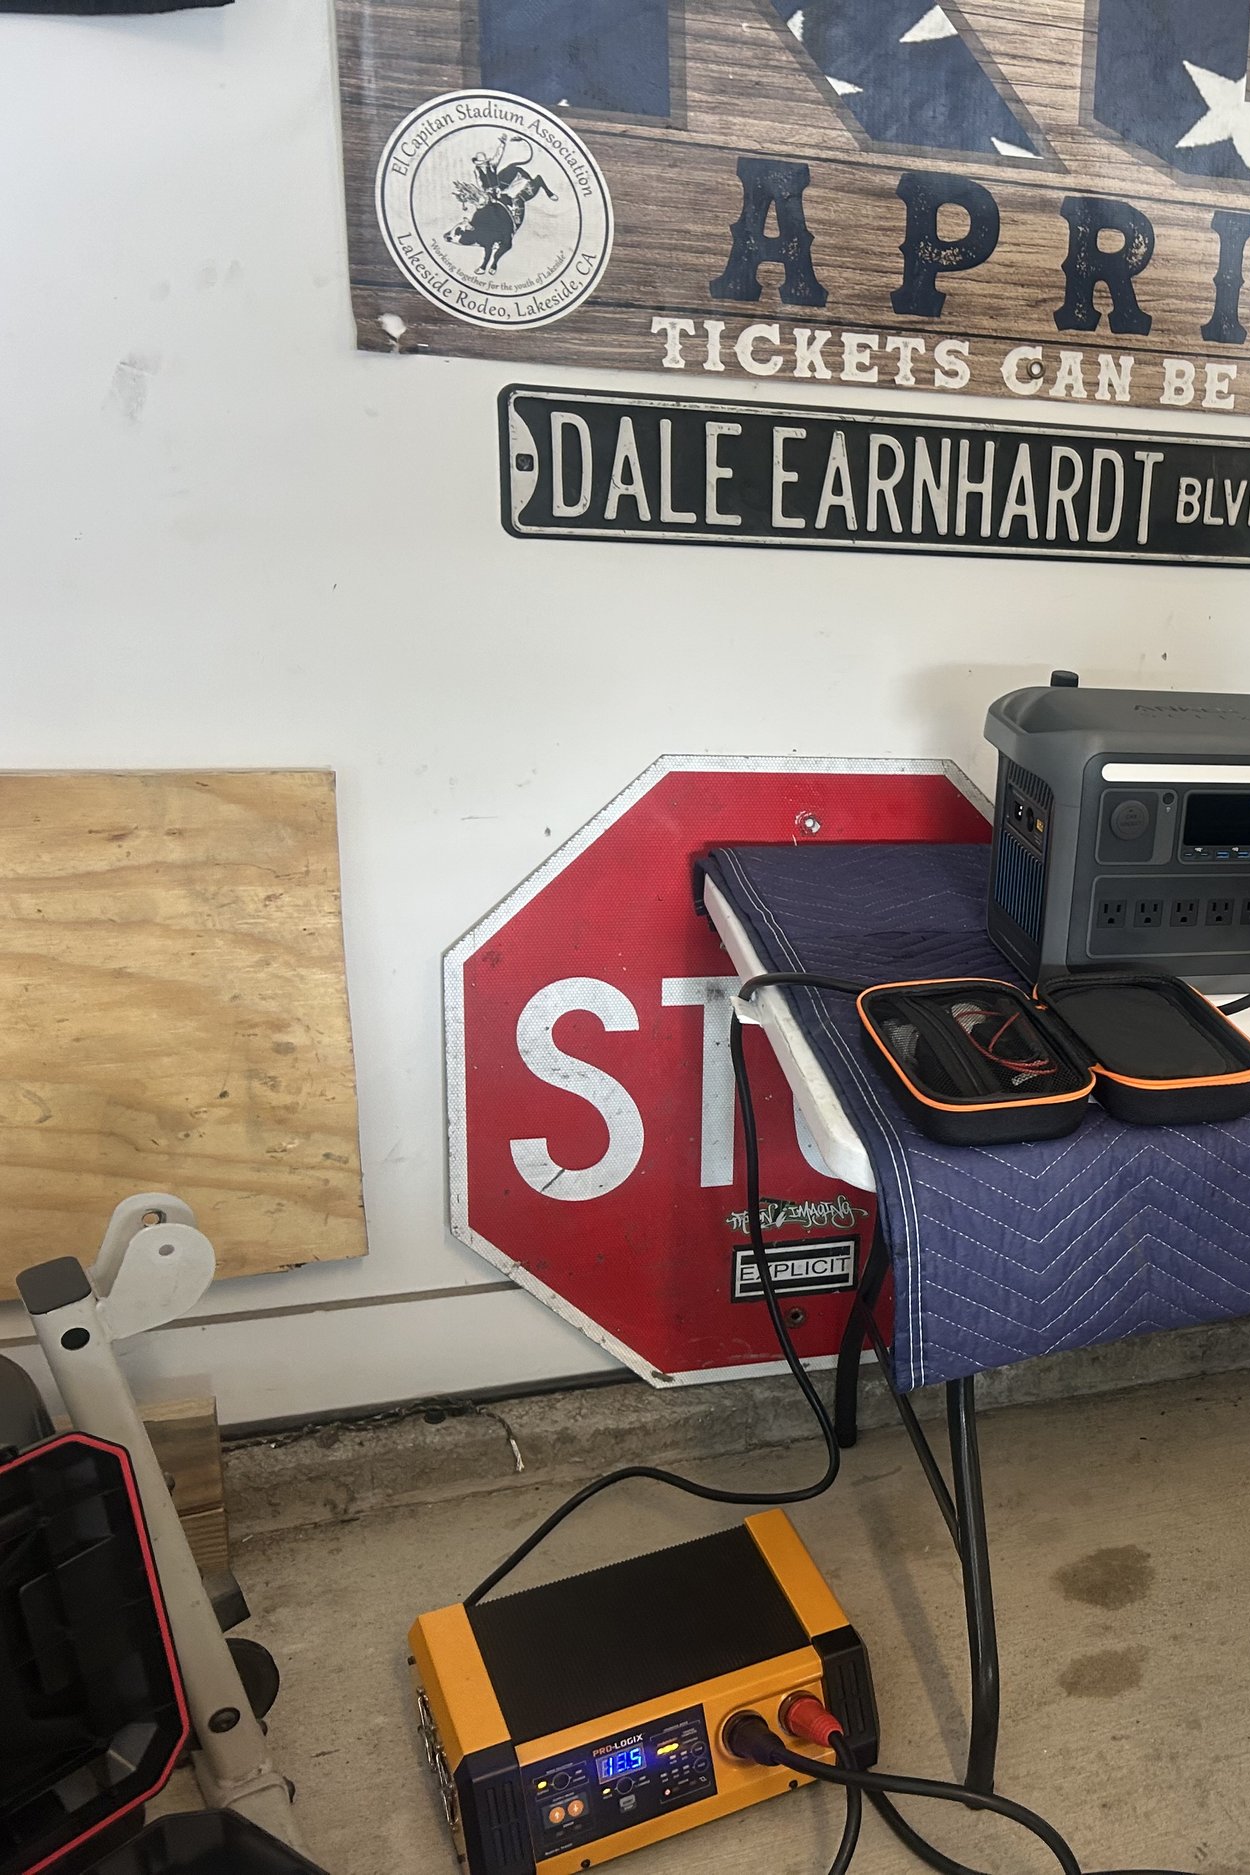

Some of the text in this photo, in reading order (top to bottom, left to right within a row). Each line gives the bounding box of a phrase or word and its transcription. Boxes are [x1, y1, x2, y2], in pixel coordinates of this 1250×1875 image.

[391, 99, 594, 198] El Capitan Stadium Association
[396, 232, 598, 321] Lakeside Rodeo, Lakeside, CA
[456, 267, 487, 288] together
[487, 281, 500, 291] for
[500, 282, 513, 291] the
[513, 280, 535, 293] youth
[650, 315, 972, 390] TICKETS
[1000, 346, 1135, 402] CAN
[1160, 358, 1238, 411] BE
[550, 410, 744, 527] DALE
[772, 425, 1165, 546] EARNHARDT
[592, 1732, 645, 1758] PRO-LOGIX
